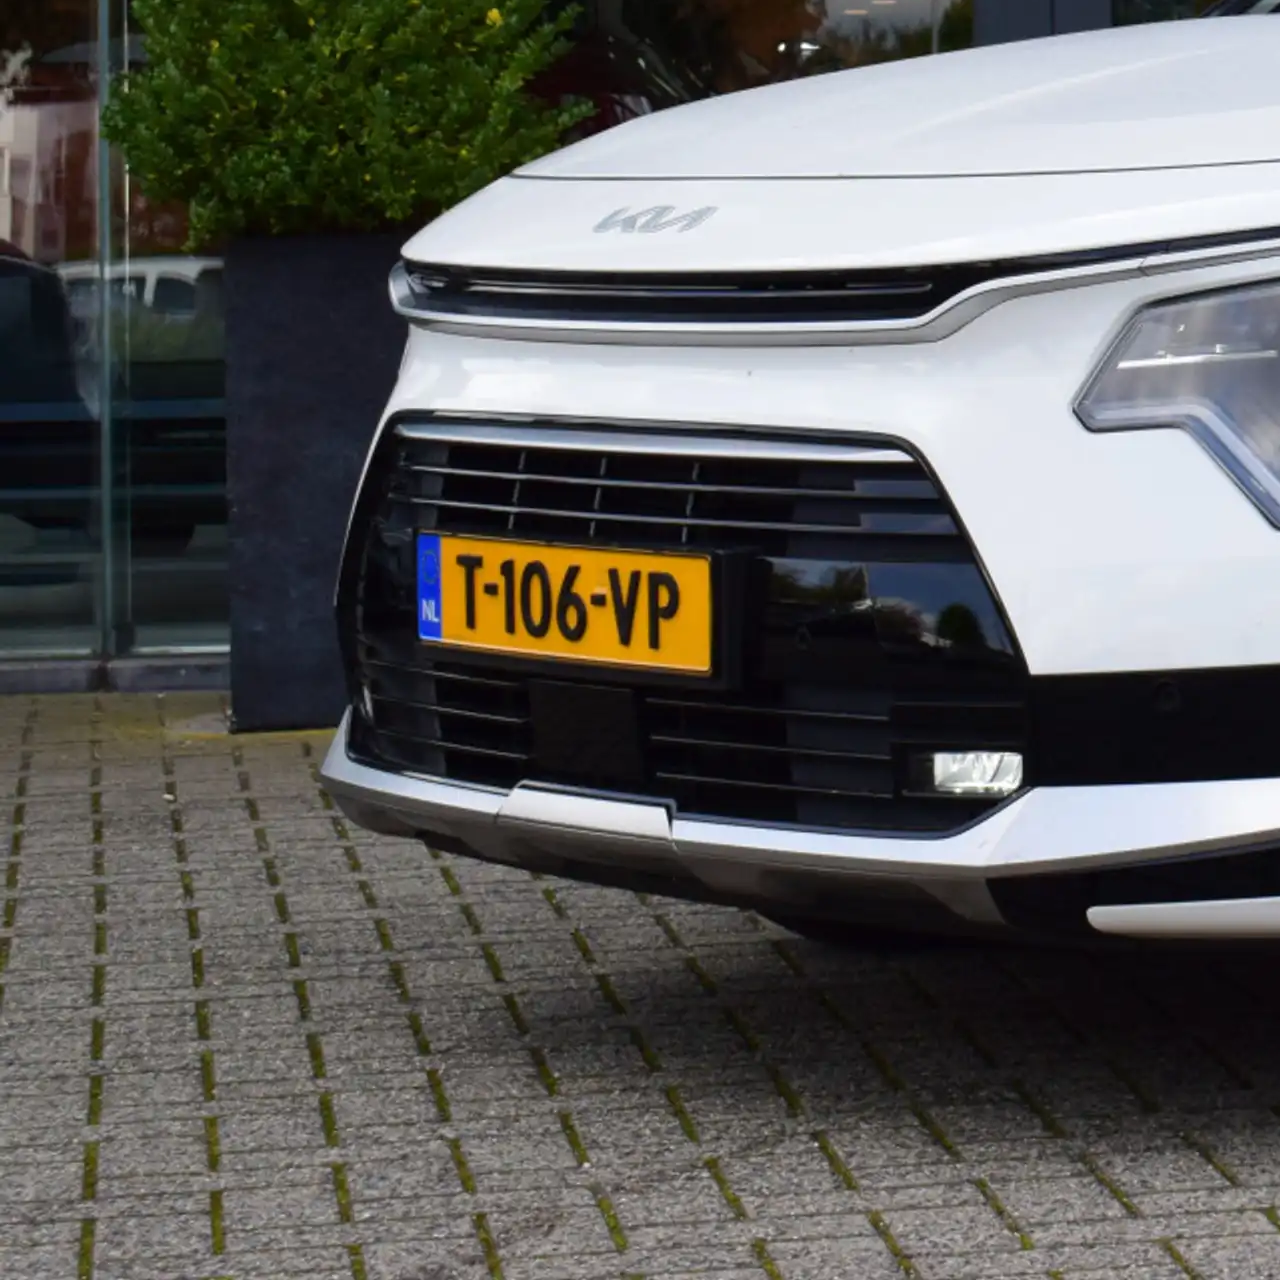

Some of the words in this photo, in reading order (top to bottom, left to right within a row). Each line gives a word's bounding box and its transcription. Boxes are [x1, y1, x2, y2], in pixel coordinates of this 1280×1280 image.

[592, 205, 720, 234] KIA
[421, 598, 441, 623] NL
[455, 553, 681, 651] T-106-VP
